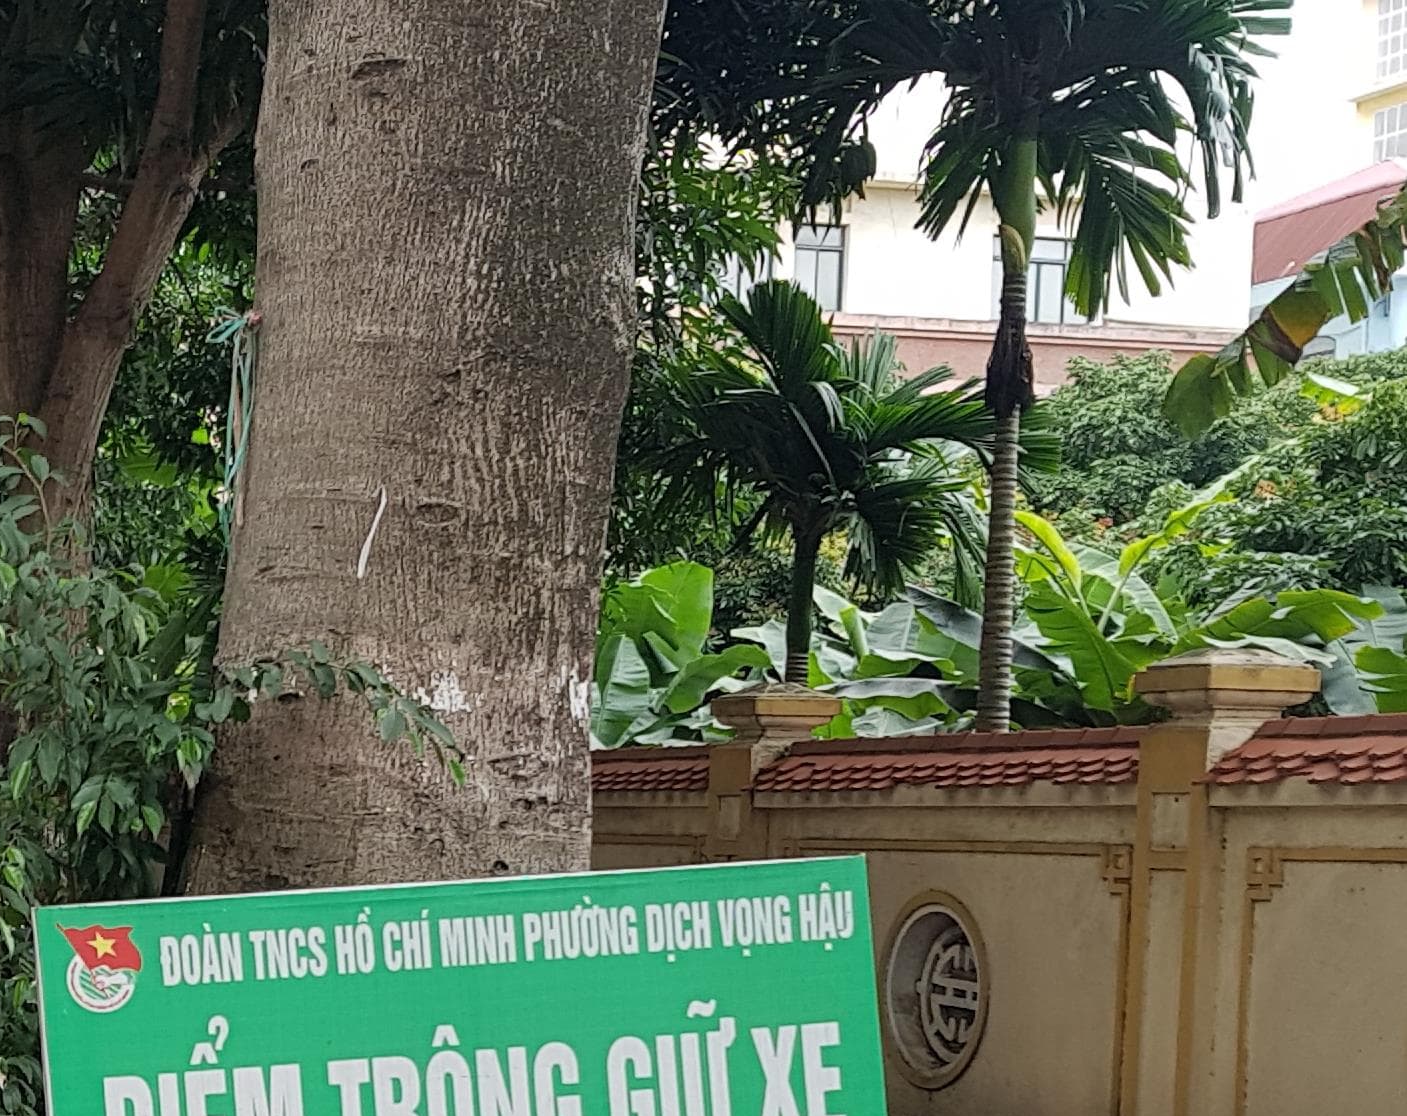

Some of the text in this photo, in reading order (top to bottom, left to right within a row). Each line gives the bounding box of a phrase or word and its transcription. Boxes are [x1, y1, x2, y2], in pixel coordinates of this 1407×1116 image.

[159, 882, 854, 987] ĐOÀN TNCS HỒ CHÍ MINH PHƯỜNG DỊCH VỌNG HẬU
